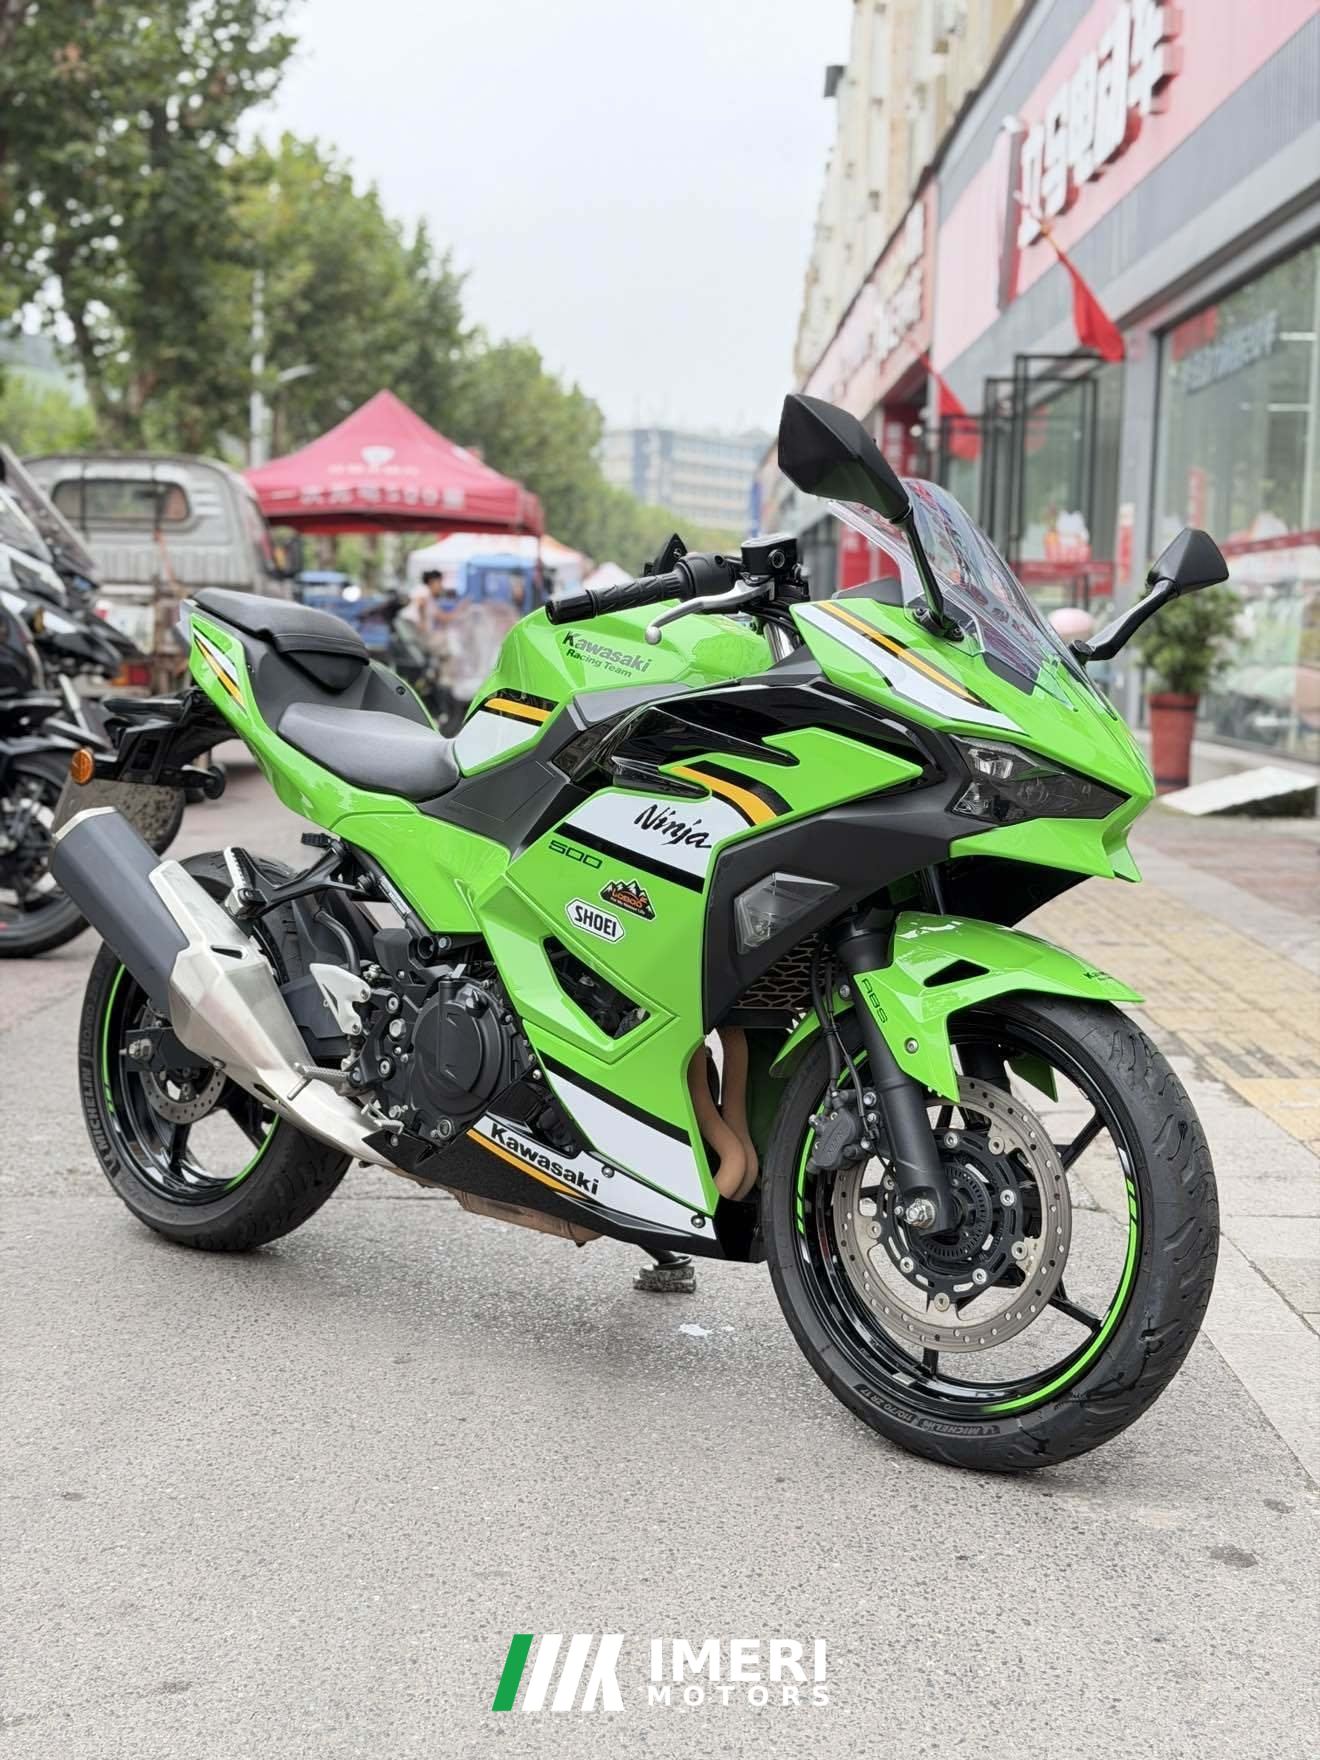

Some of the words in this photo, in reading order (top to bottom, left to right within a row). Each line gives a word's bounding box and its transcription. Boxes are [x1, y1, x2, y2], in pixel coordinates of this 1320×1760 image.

[562, 630, 652, 673] Kawasaki
[566, 648, 603, 668] Racing
[603, 661, 632, 678] Team
[633, 804, 712, 848] Ninja
[549, 840, 603, 870] 500
[574, 905, 617, 937] SHOEI
[862, 978, 888, 1023] ABS
[82, 1067, 109, 1150] MICHELIN
[490, 1122, 599, 1195] Kawasaki
